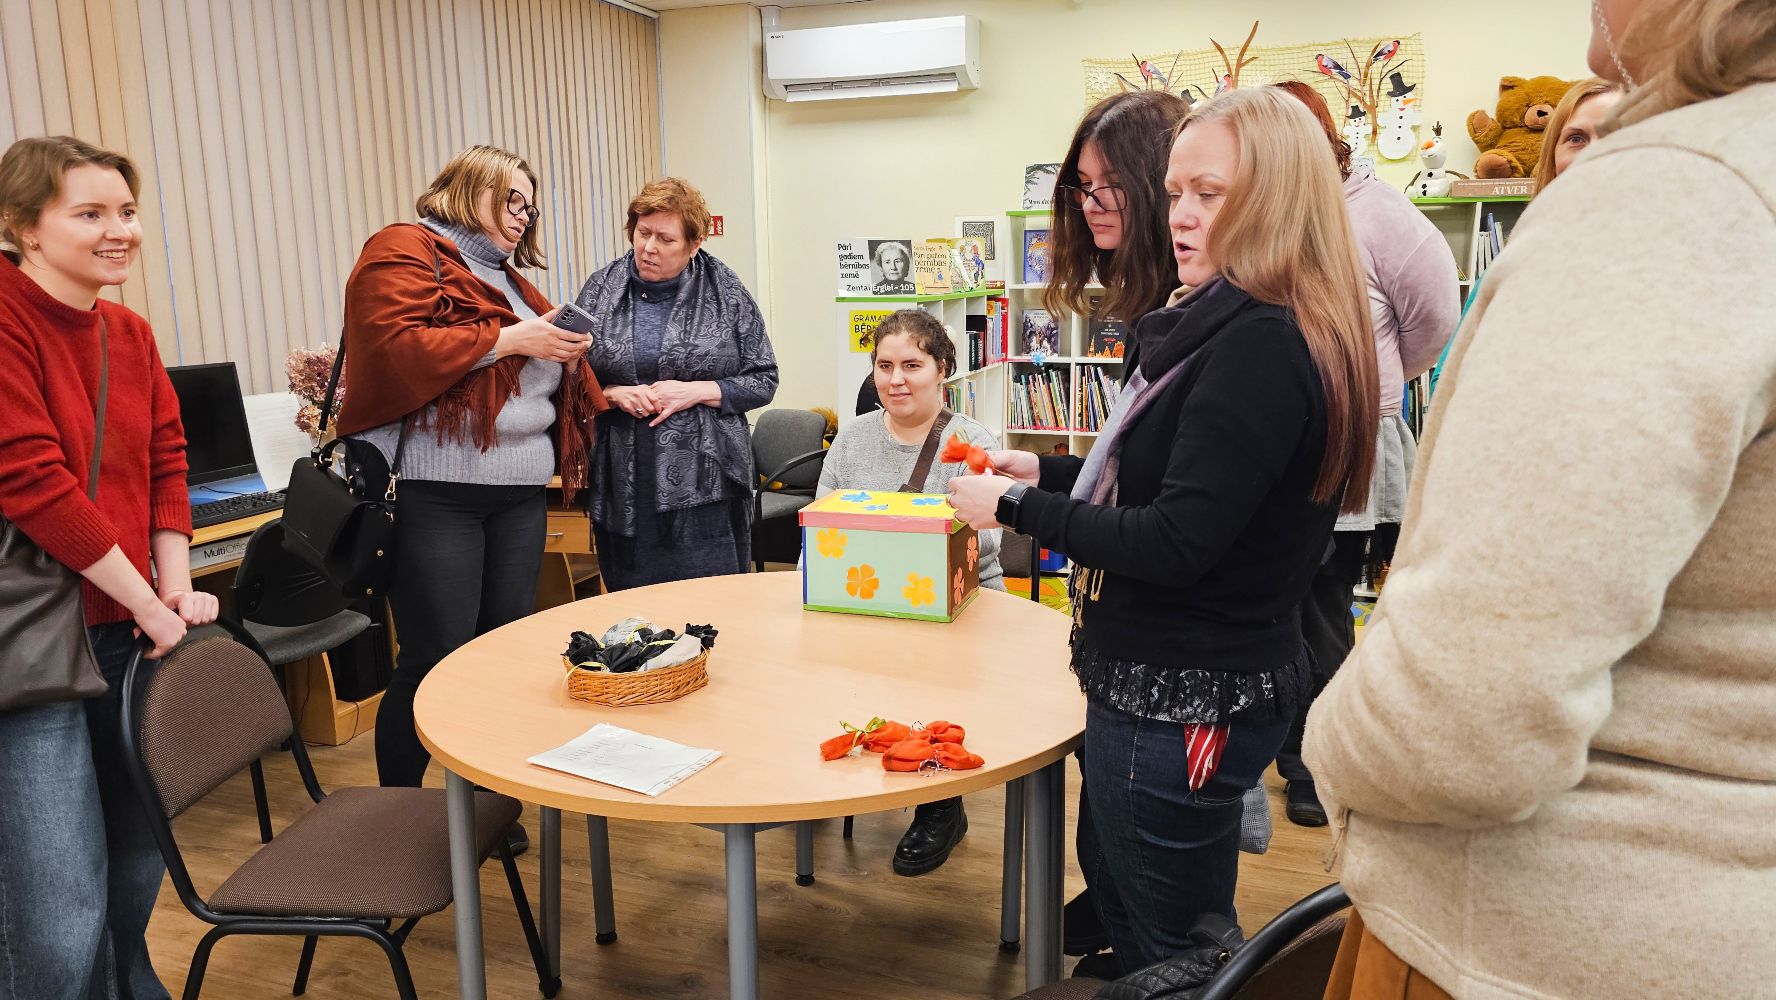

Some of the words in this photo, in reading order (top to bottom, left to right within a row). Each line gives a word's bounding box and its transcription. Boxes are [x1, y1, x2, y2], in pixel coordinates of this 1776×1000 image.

[838, 252, 864, 261] gadiem
[839, 262, 870, 270] bērnības
[840, 271, 860, 279] zemē
[899, 283, 915, 291] 105
